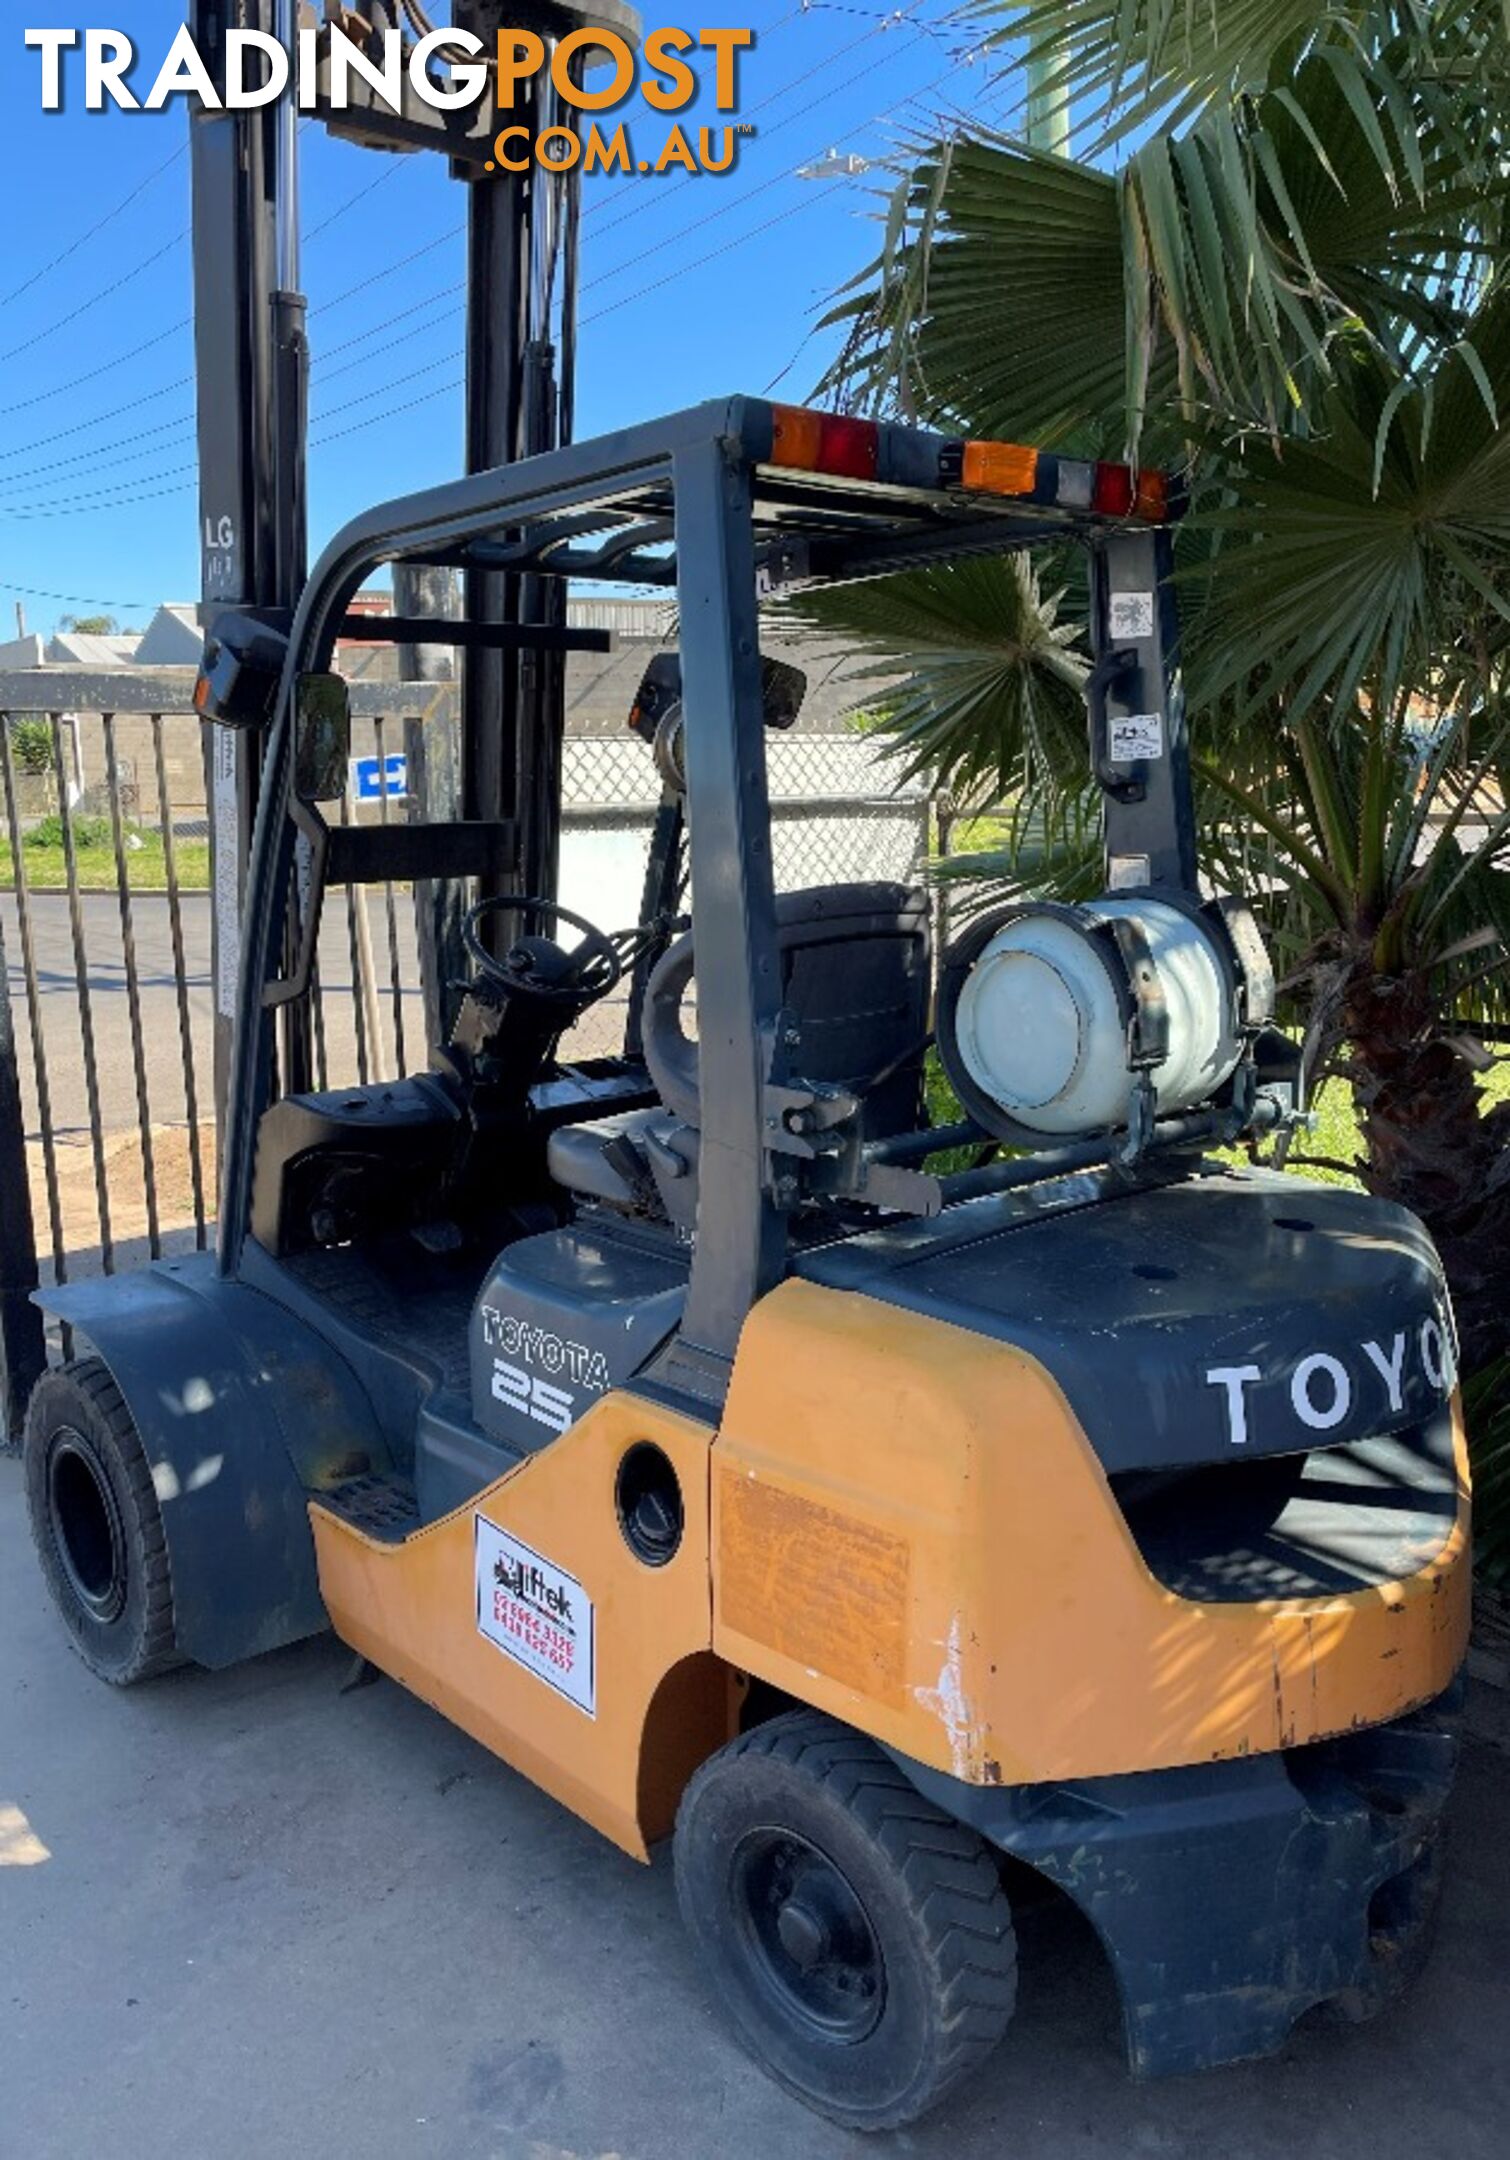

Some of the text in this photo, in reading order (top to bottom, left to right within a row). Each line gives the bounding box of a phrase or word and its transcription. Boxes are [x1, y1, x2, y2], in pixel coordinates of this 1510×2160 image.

[205, 514, 234, 550] LG
[481, 1304, 610, 1390] TOYOTA
[491, 1357, 575, 1435] 25
